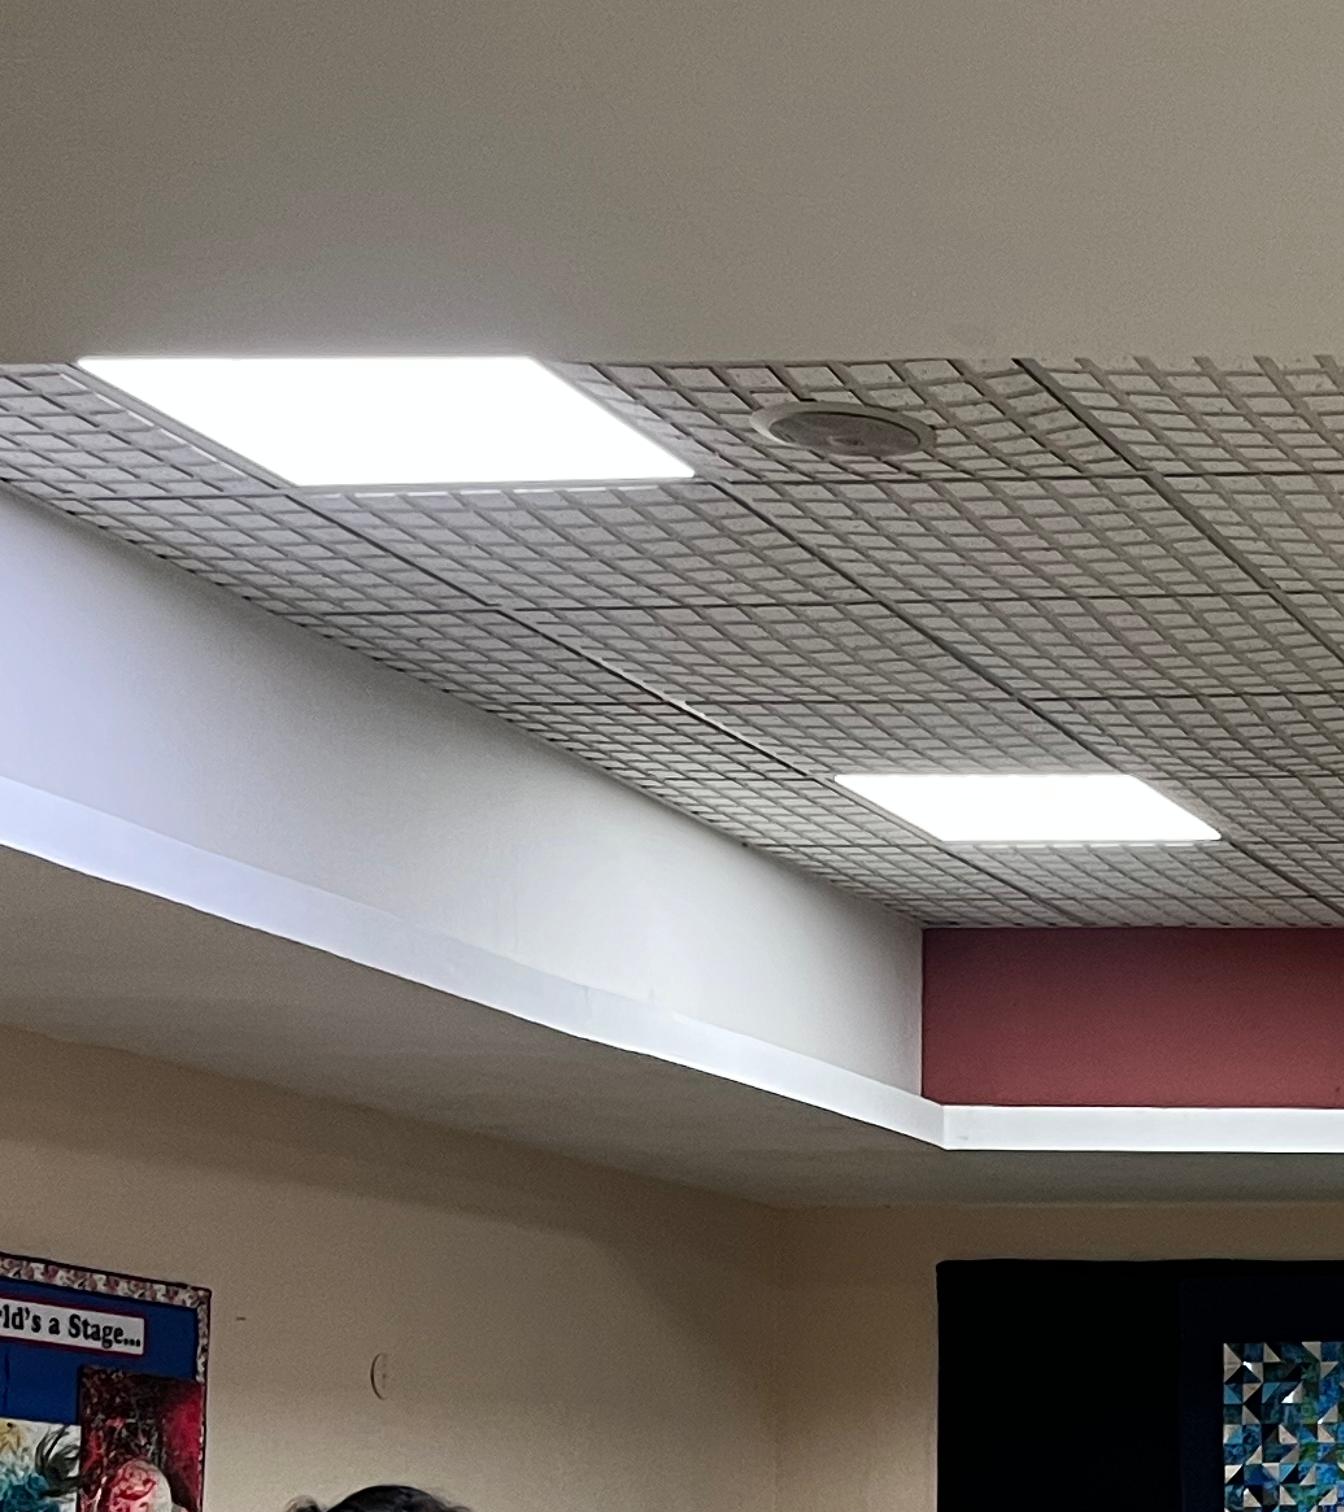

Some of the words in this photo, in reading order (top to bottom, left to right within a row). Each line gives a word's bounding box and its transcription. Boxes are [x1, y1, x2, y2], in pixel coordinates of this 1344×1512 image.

[0, 1304, 41, 1333] ld's
[48, 1317, 61, 1335] a
[68, 1314, 141, 1349] Stage...
